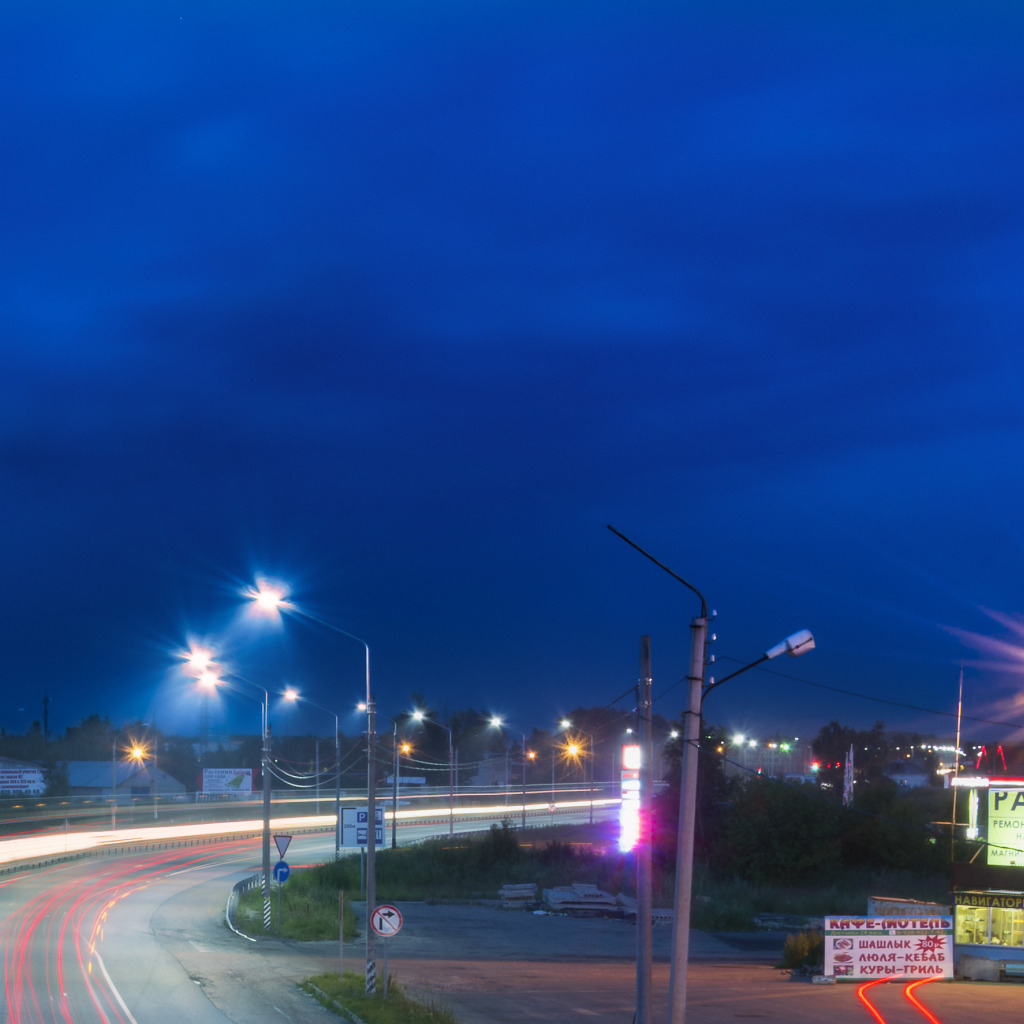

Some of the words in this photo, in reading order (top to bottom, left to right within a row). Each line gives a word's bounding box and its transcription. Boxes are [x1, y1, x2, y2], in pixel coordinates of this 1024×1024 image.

[954, 895, 1024, 908] НАВИГАТОР
[829, 918, 951, 930] КАФЕ-МОТЕЛЬ
[858, 940, 912, 949] ШАШЛЫК
[858, 952, 946, 962] ЛЮЛЯ-КЕБАБ
[859, 965, 944, 975] КУРЫ-ГРИЛЬ
